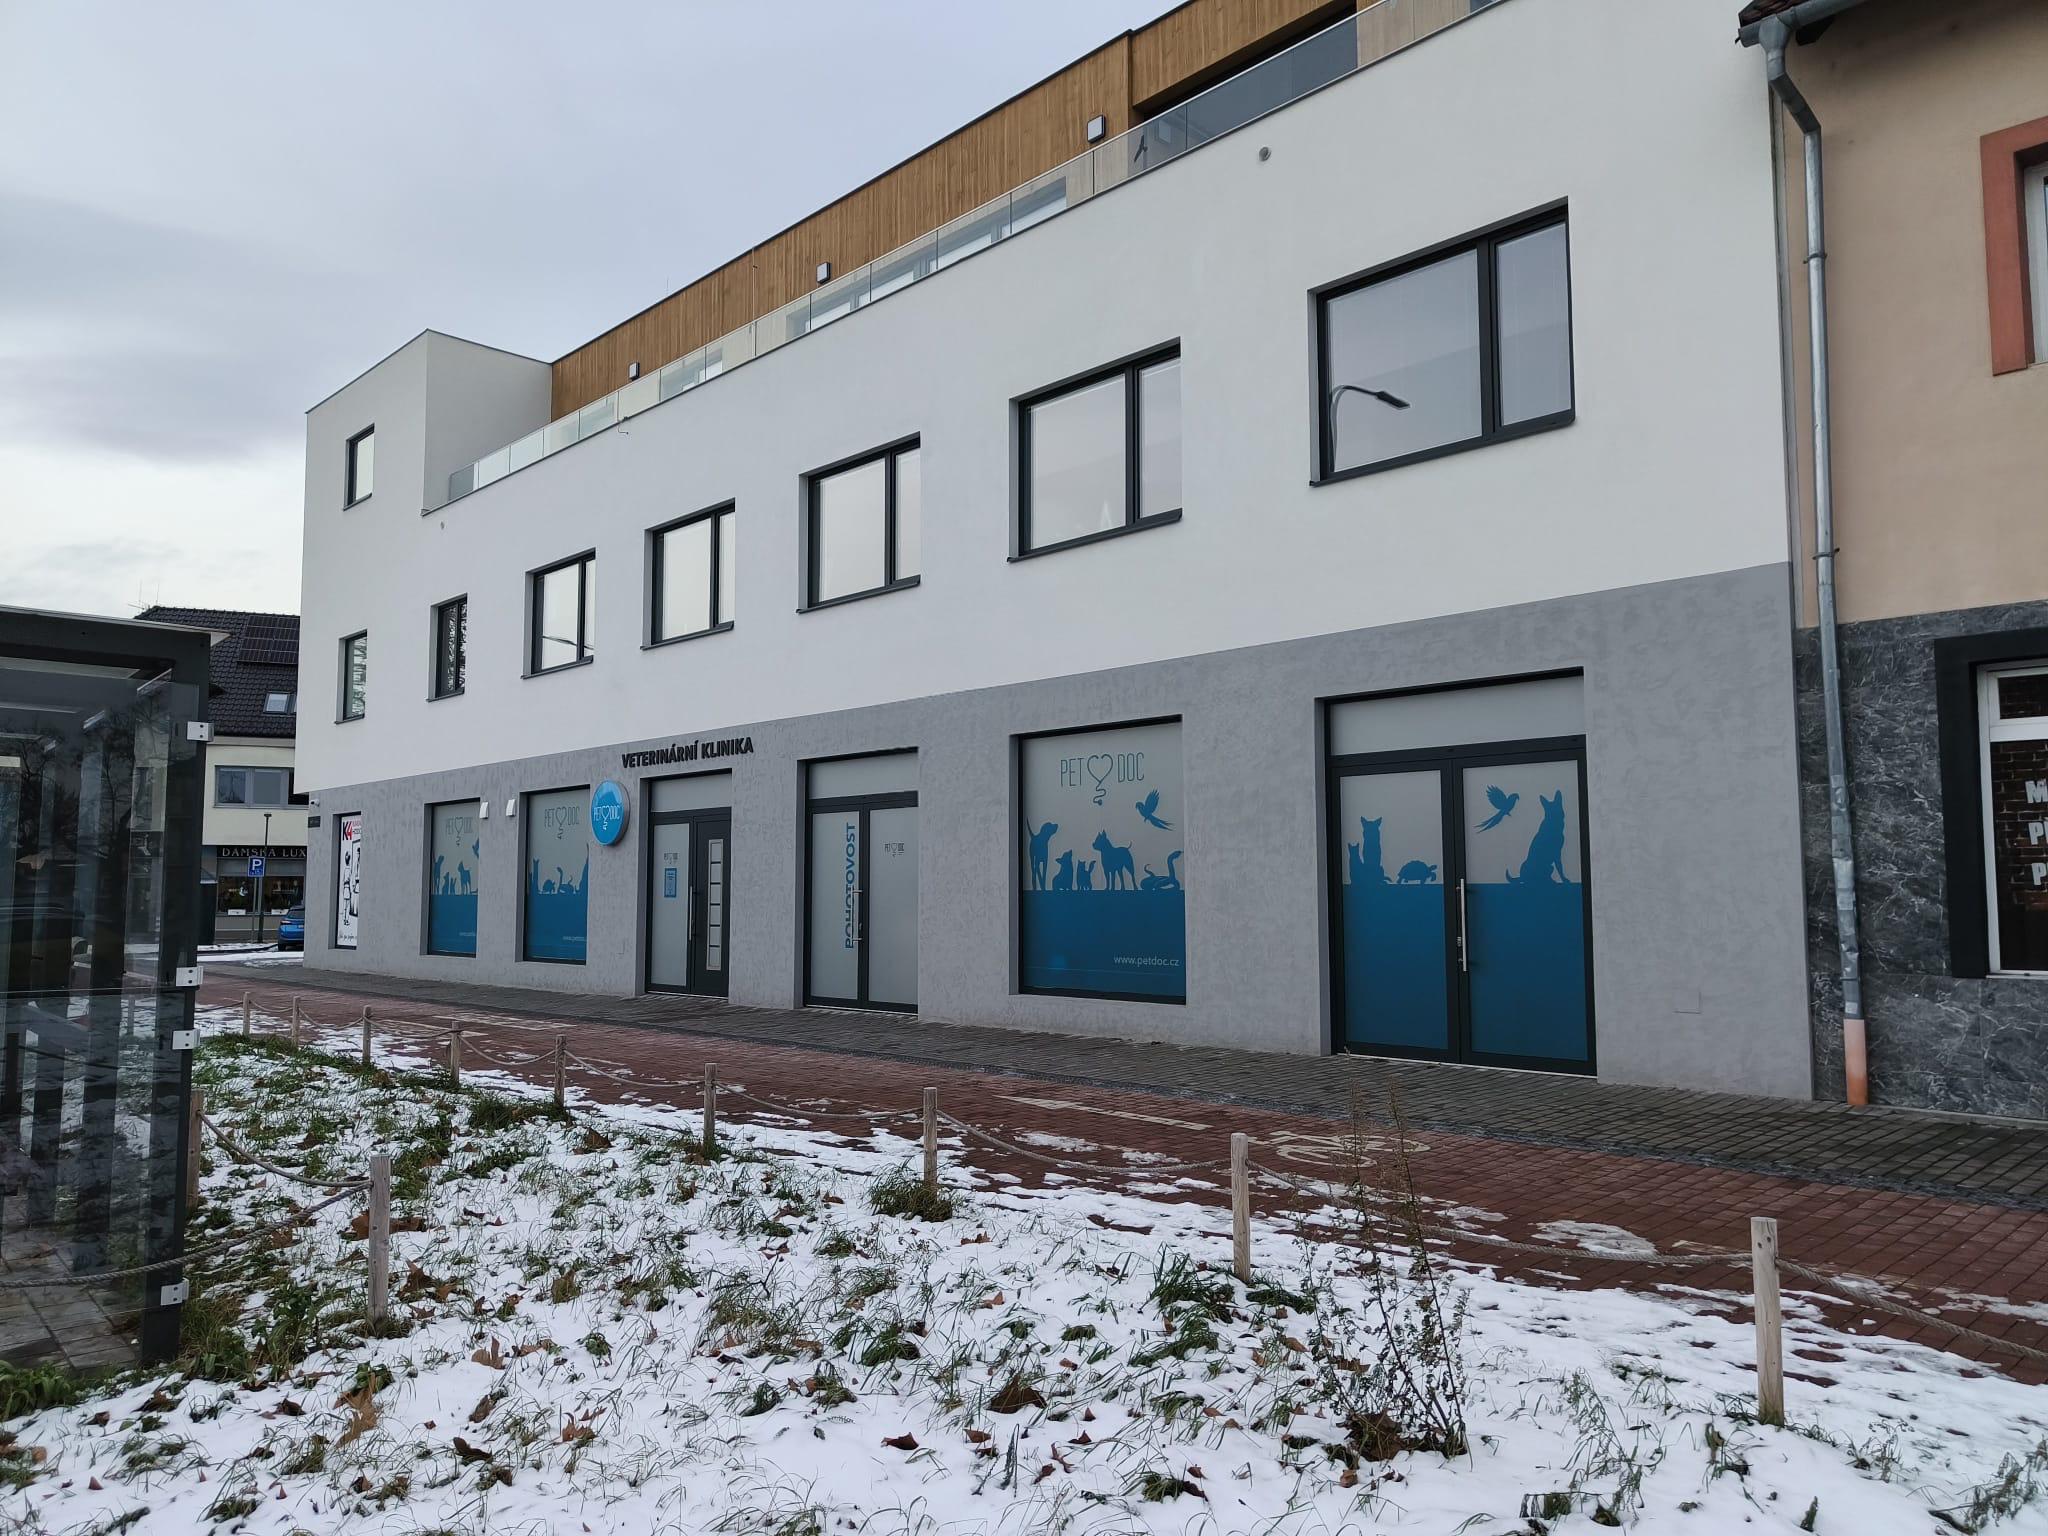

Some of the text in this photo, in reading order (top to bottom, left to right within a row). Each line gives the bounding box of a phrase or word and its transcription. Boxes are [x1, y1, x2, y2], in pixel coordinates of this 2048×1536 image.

[622, 737, 753, 768] VETERINÁRNÍ KLINIKA
[1060, 752, 1145, 787] PET DOC
[252, 858, 262, 871] P
[1113, 954, 1180, 968] www.petdoc.cz
